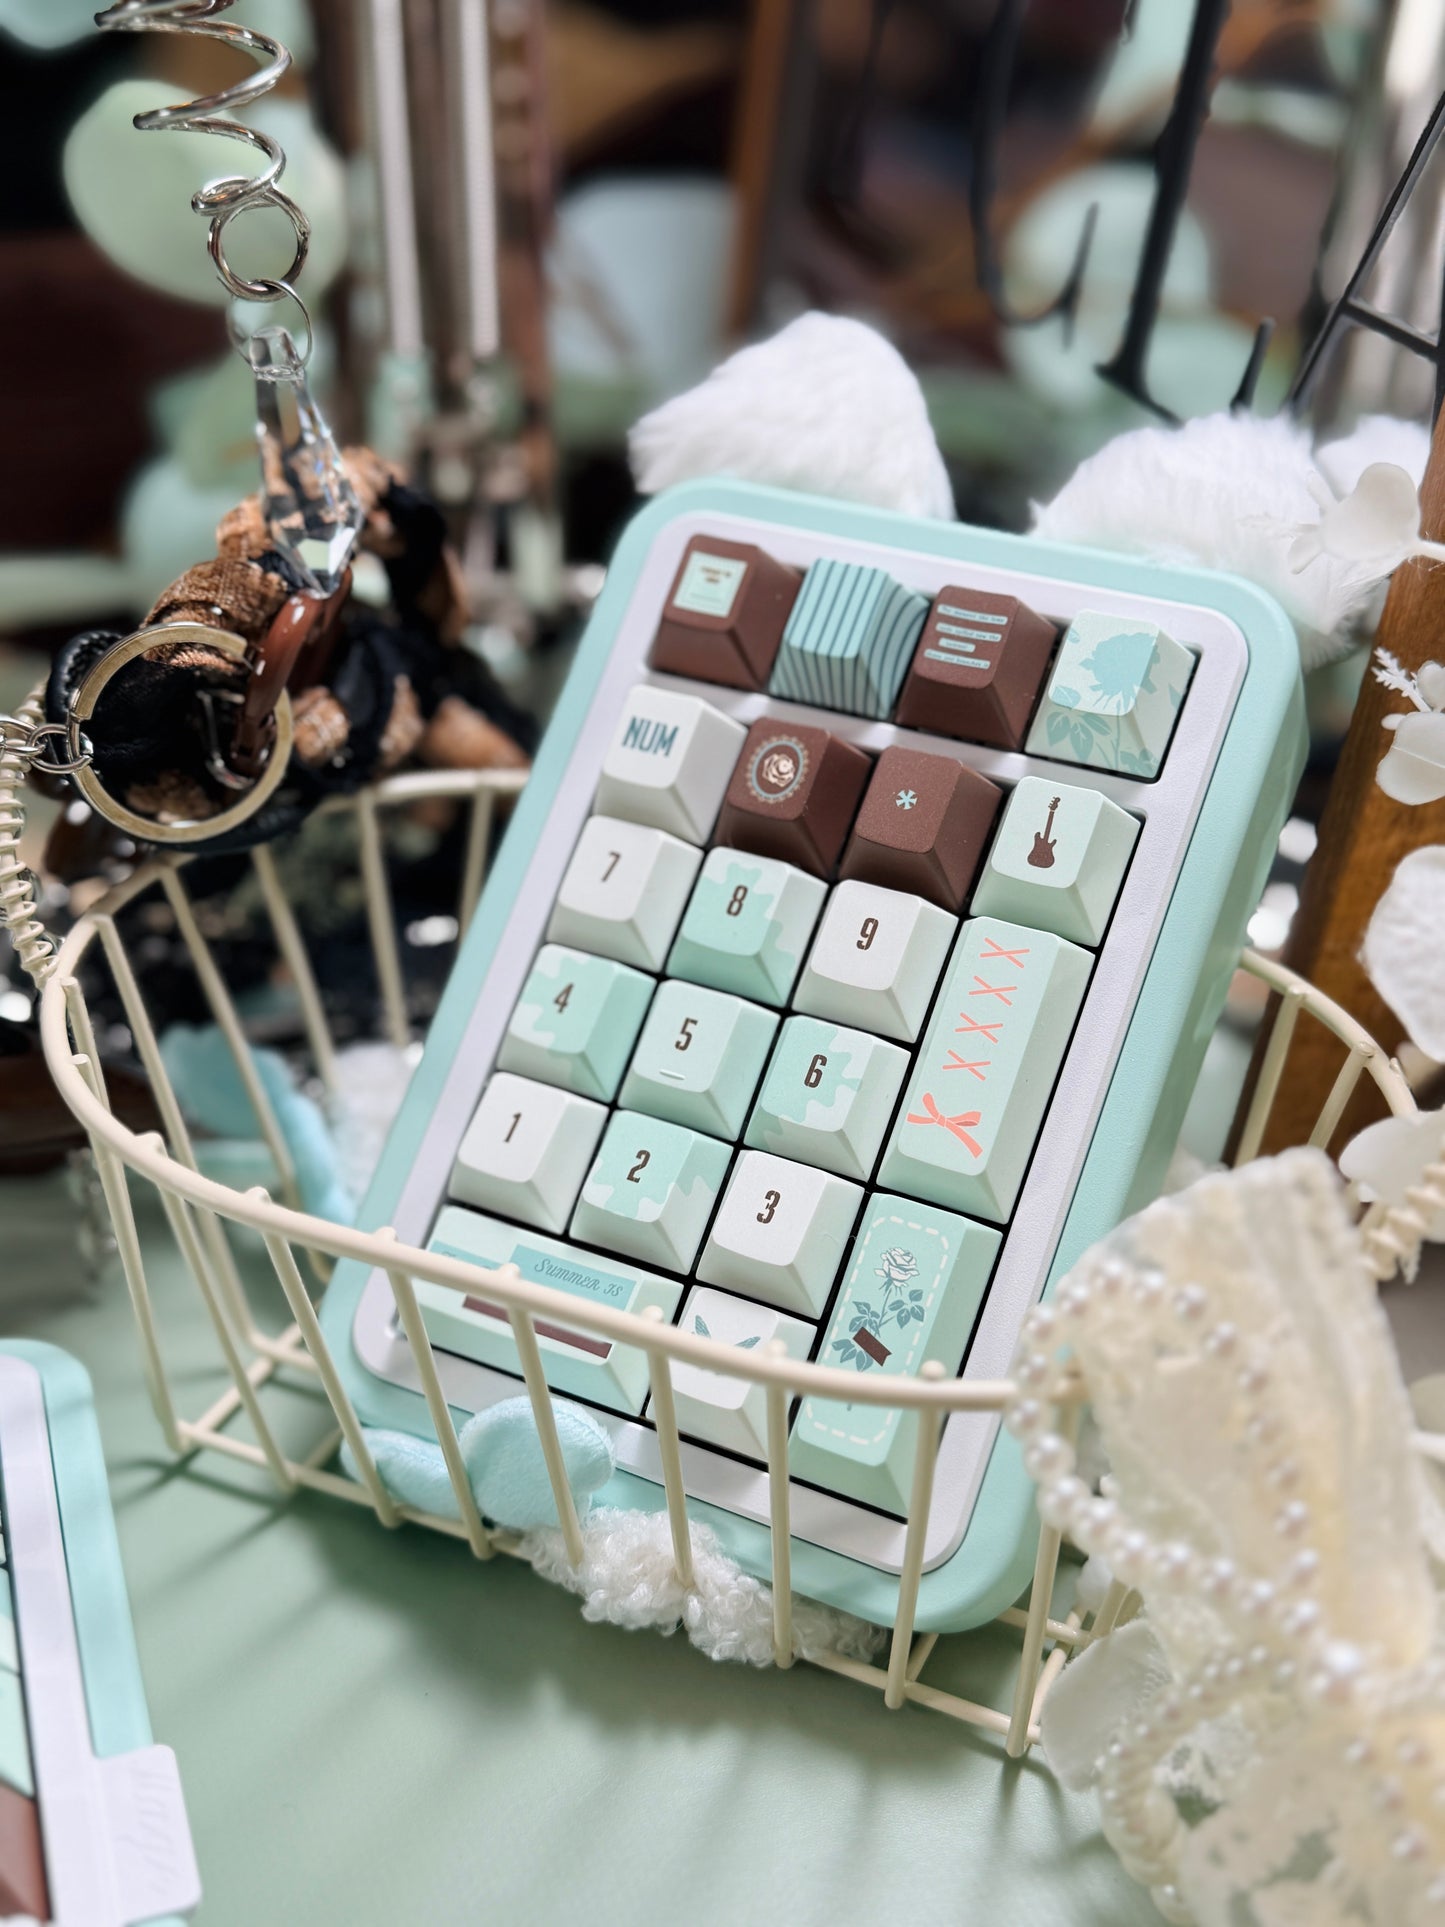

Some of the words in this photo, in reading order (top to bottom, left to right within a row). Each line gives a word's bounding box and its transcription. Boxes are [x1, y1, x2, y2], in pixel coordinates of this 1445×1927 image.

[622, 715, 679, 757] NUM
[601, 852, 621, 883] 7
[727, 885, 749, 917] 8
[857, 918, 879, 951] 9
[553, 983, 574, 1014] 4
[675, 1018, 699, 1052] 5
[804, 1054, 829, 1089] 6
[504, 1112, 522, 1143] 1
[627, 1149, 652, 1184] 2
[757, 1190, 781, 1225] 3
